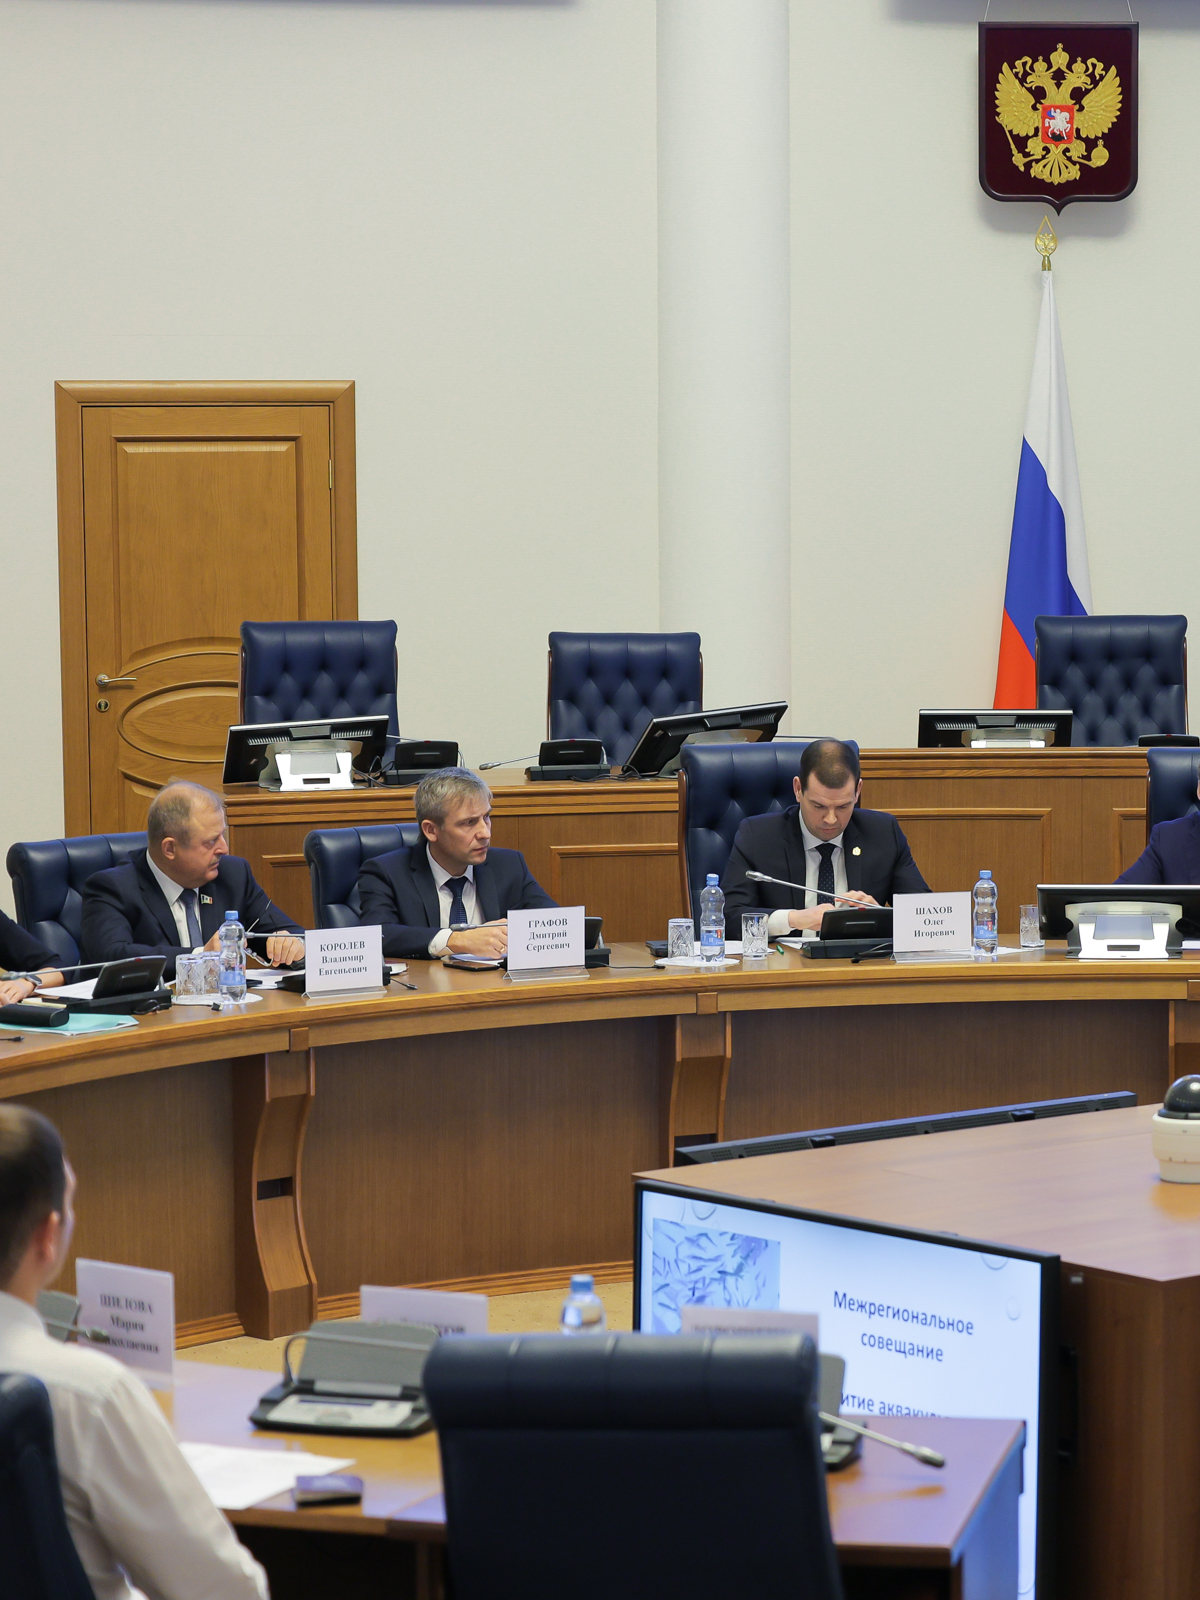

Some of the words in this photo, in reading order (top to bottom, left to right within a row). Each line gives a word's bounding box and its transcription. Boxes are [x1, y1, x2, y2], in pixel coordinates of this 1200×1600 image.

[915, 906, 953, 915] ШАХОВ
[528, 917, 568, 929] ГРАФОВ
[923, 918, 945, 928] Олег
[528, 929, 568, 941] Дмитрий
[914, 929, 955, 939] Игоревич
[319, 941, 366, 952] КОРОЛЕВ
[526, 941, 570, 953] Сергеевич
[321, 953, 364, 965] Владимир
[318, 965, 368, 977] Евгеньевич
[832, 1290, 975, 1337] Межрегиональное
[860, 1330, 944, 1363] совещание
